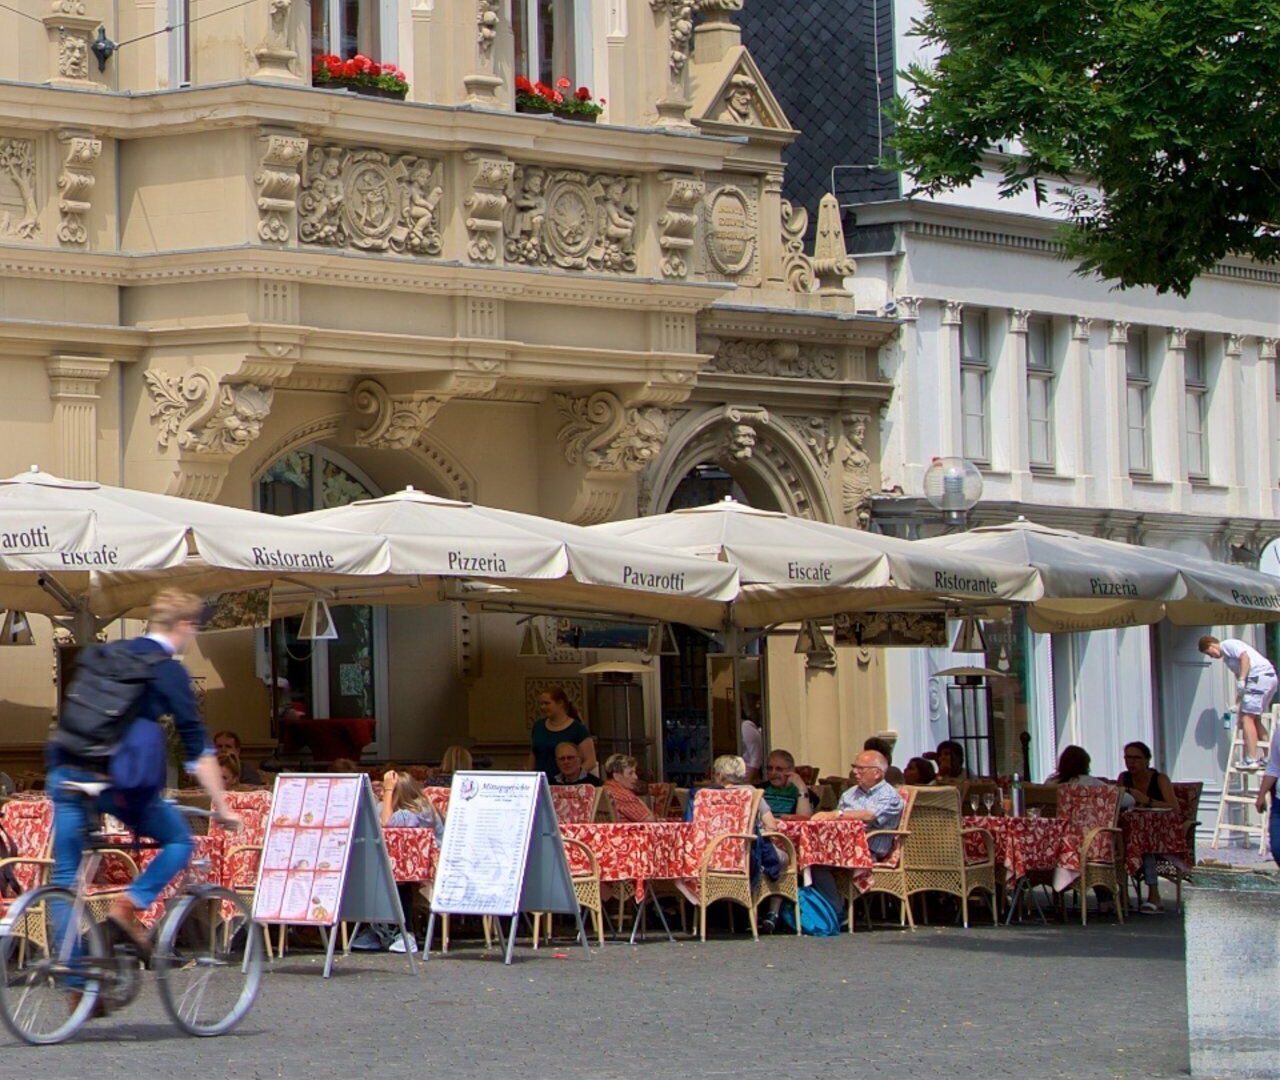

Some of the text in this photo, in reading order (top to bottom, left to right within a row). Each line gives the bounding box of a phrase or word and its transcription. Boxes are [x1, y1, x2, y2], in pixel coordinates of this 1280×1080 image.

[251, 546, 335, 569] Ristorante
[447, 551, 507, 573] Pizzeria
[622, 565, 685, 593] Pavarotti
[934, 571, 998, 595] Ristorante
[1090, 578, 1139, 597] Pizzeria
[1230, 589, 1280, 609] Pavarott
